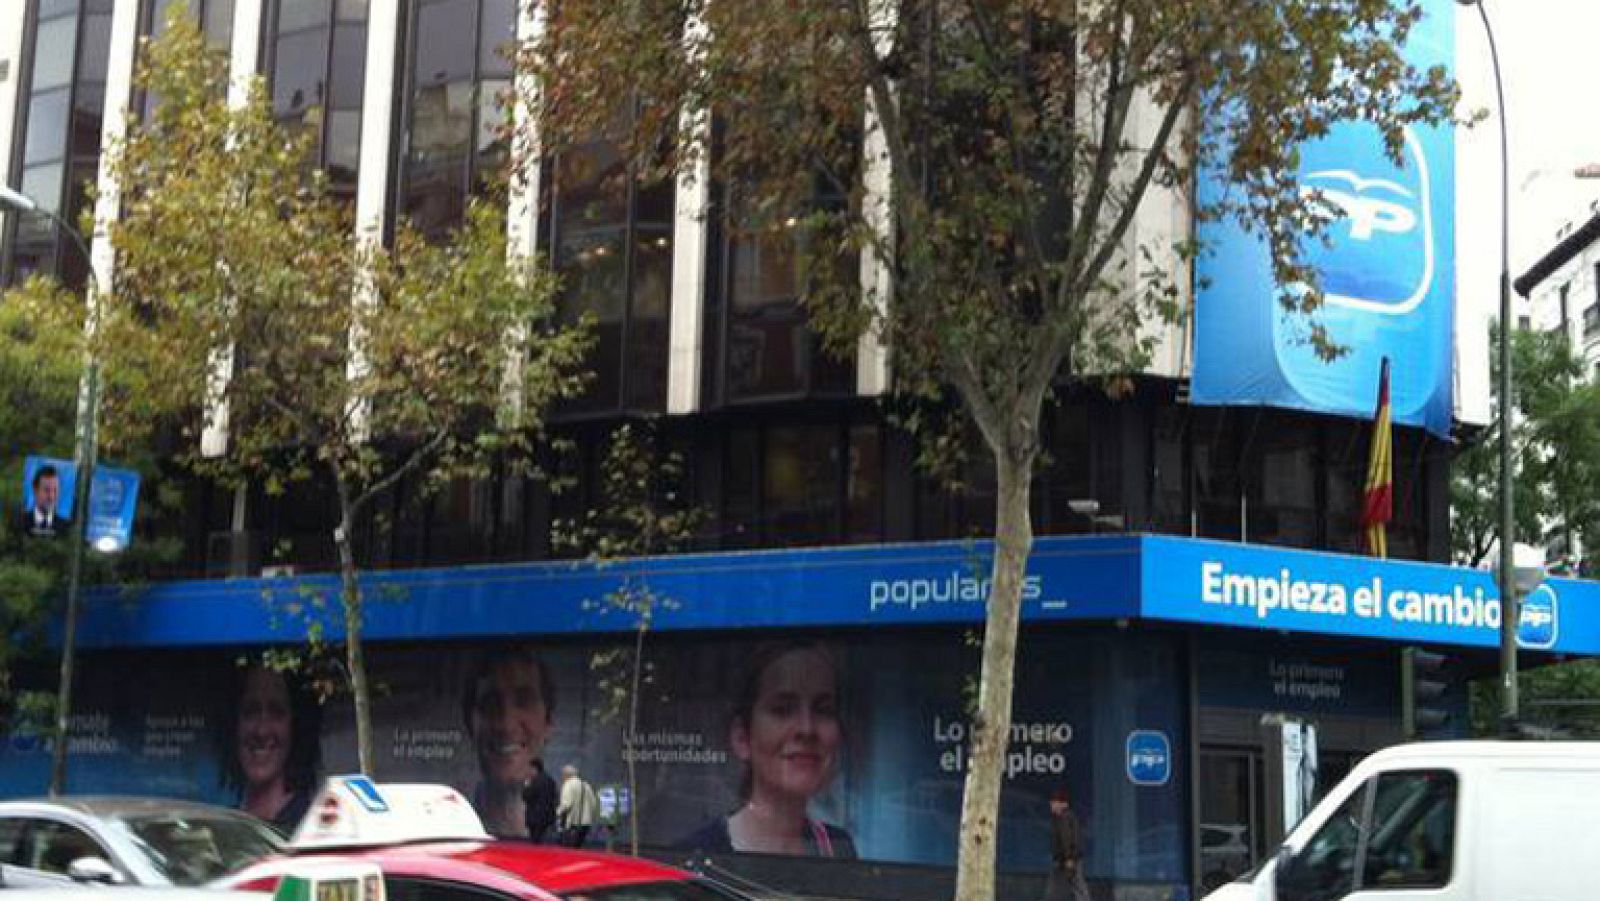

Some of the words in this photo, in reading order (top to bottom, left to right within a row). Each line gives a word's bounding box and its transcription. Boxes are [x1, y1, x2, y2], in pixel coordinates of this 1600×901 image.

[1201, 561, 1347, 618] Empieza
[1353, 577, 1383, 617] el
[1387, 586, 1501, 627] cambio
[934, 716, 964, 743] Lo
[969, 721, 1073, 744] mero
[940, 744, 962, 771] el
